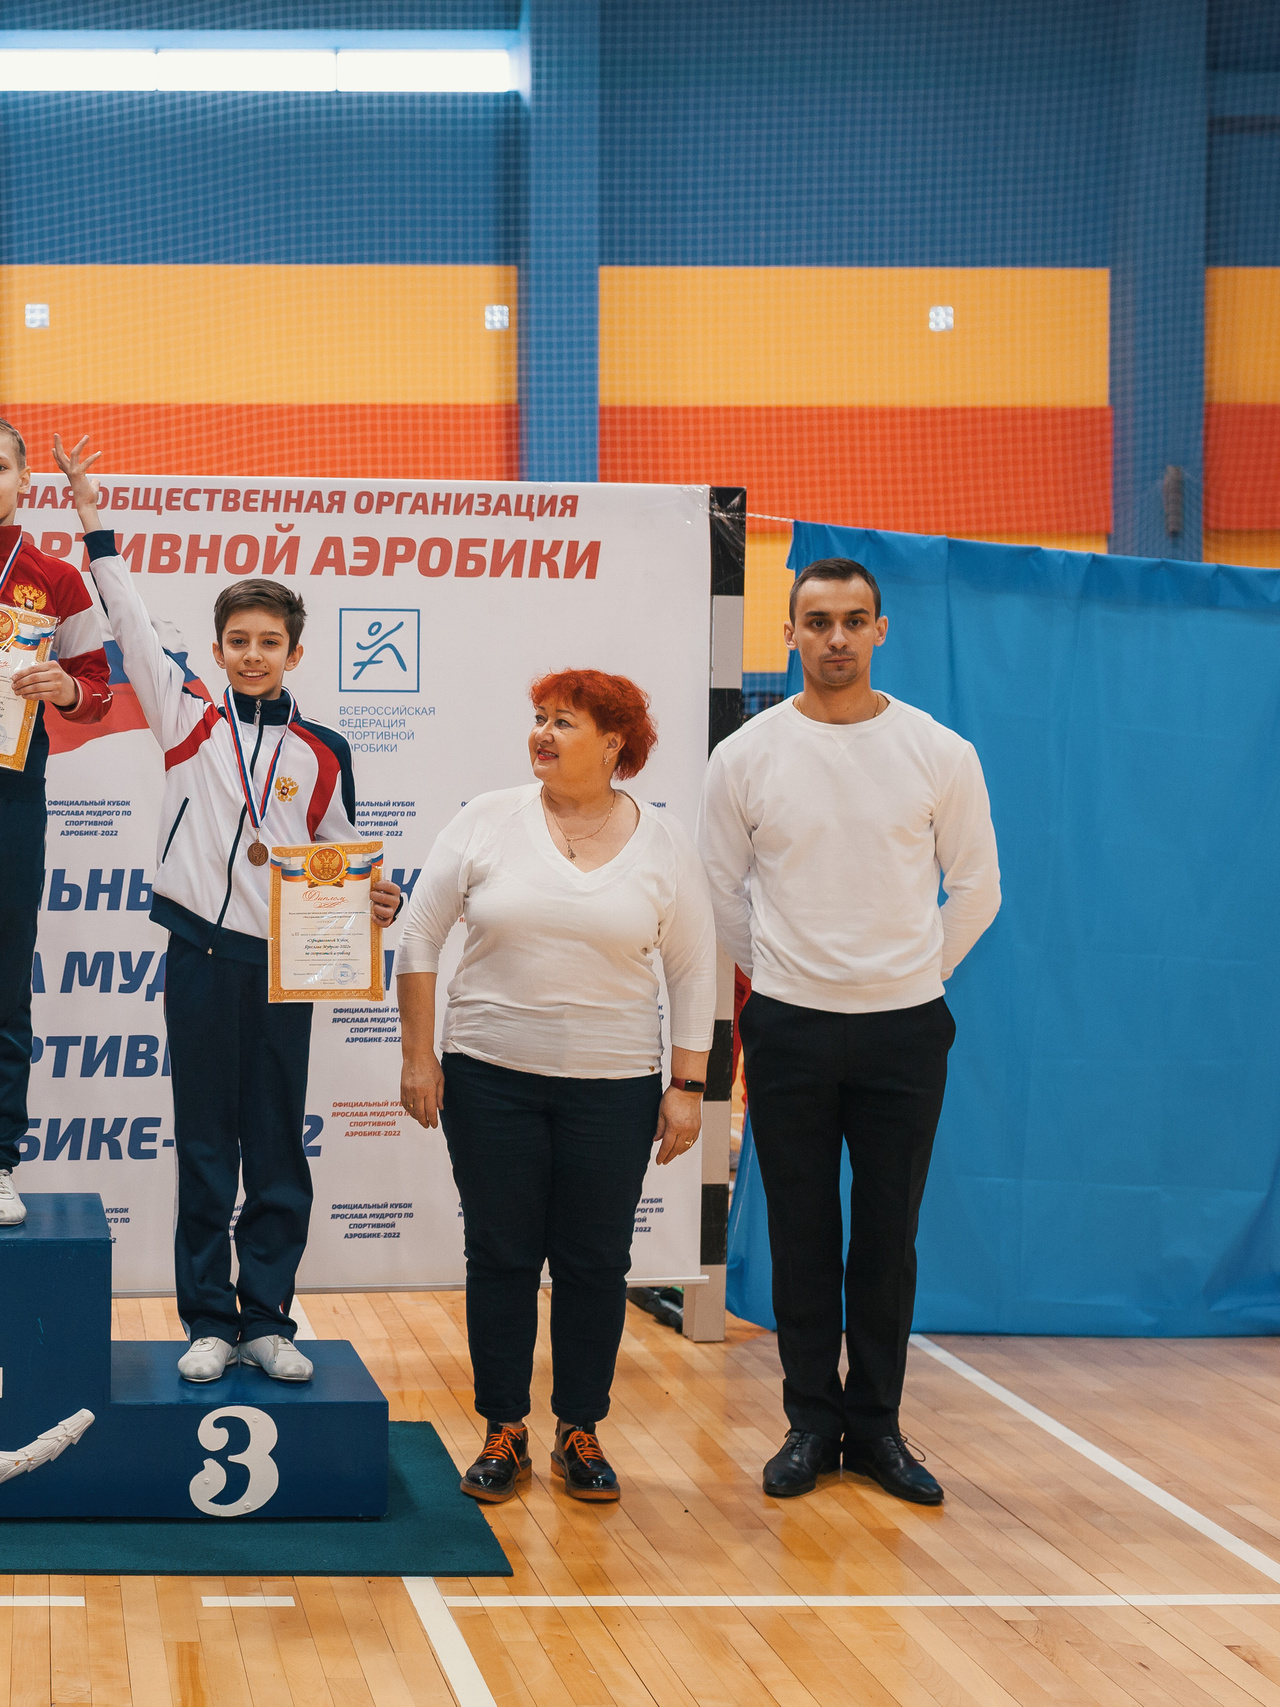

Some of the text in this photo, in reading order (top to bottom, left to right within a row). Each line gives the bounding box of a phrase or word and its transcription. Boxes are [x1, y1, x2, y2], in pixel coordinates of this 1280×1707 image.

[353, 491, 578, 520] ОРГАНИЗАЦИЯ
[310, 535, 602, 580] АЭРОБИКИ
[339, 705, 436, 716] ВСЕРОССИЙСКАЯ
[339, 719, 406, 730] ФЕДЕРАЦИЯ
[351, 744, 398, 752] РОБИКИ
[47, 799, 106, 807] ОФИЦИАЛЬНЫЙ
[333, 1006, 390, 1014] ОФИЦИАЛЬНЫЙ
[332, 1100, 389, 1108] ОФИЦИАЛЬНЫЙ
[349, 1119, 396, 1127] СПОРТИВНОЙ
[332, 1202, 388, 1210] ОФИЦИАЛЬНЫЙ
[369, 1212, 402, 1220] МУДРОГО
[349, 1221, 396, 1229] СПОРТИВНОЙ
[189, 1405, 280, 1518] 3
